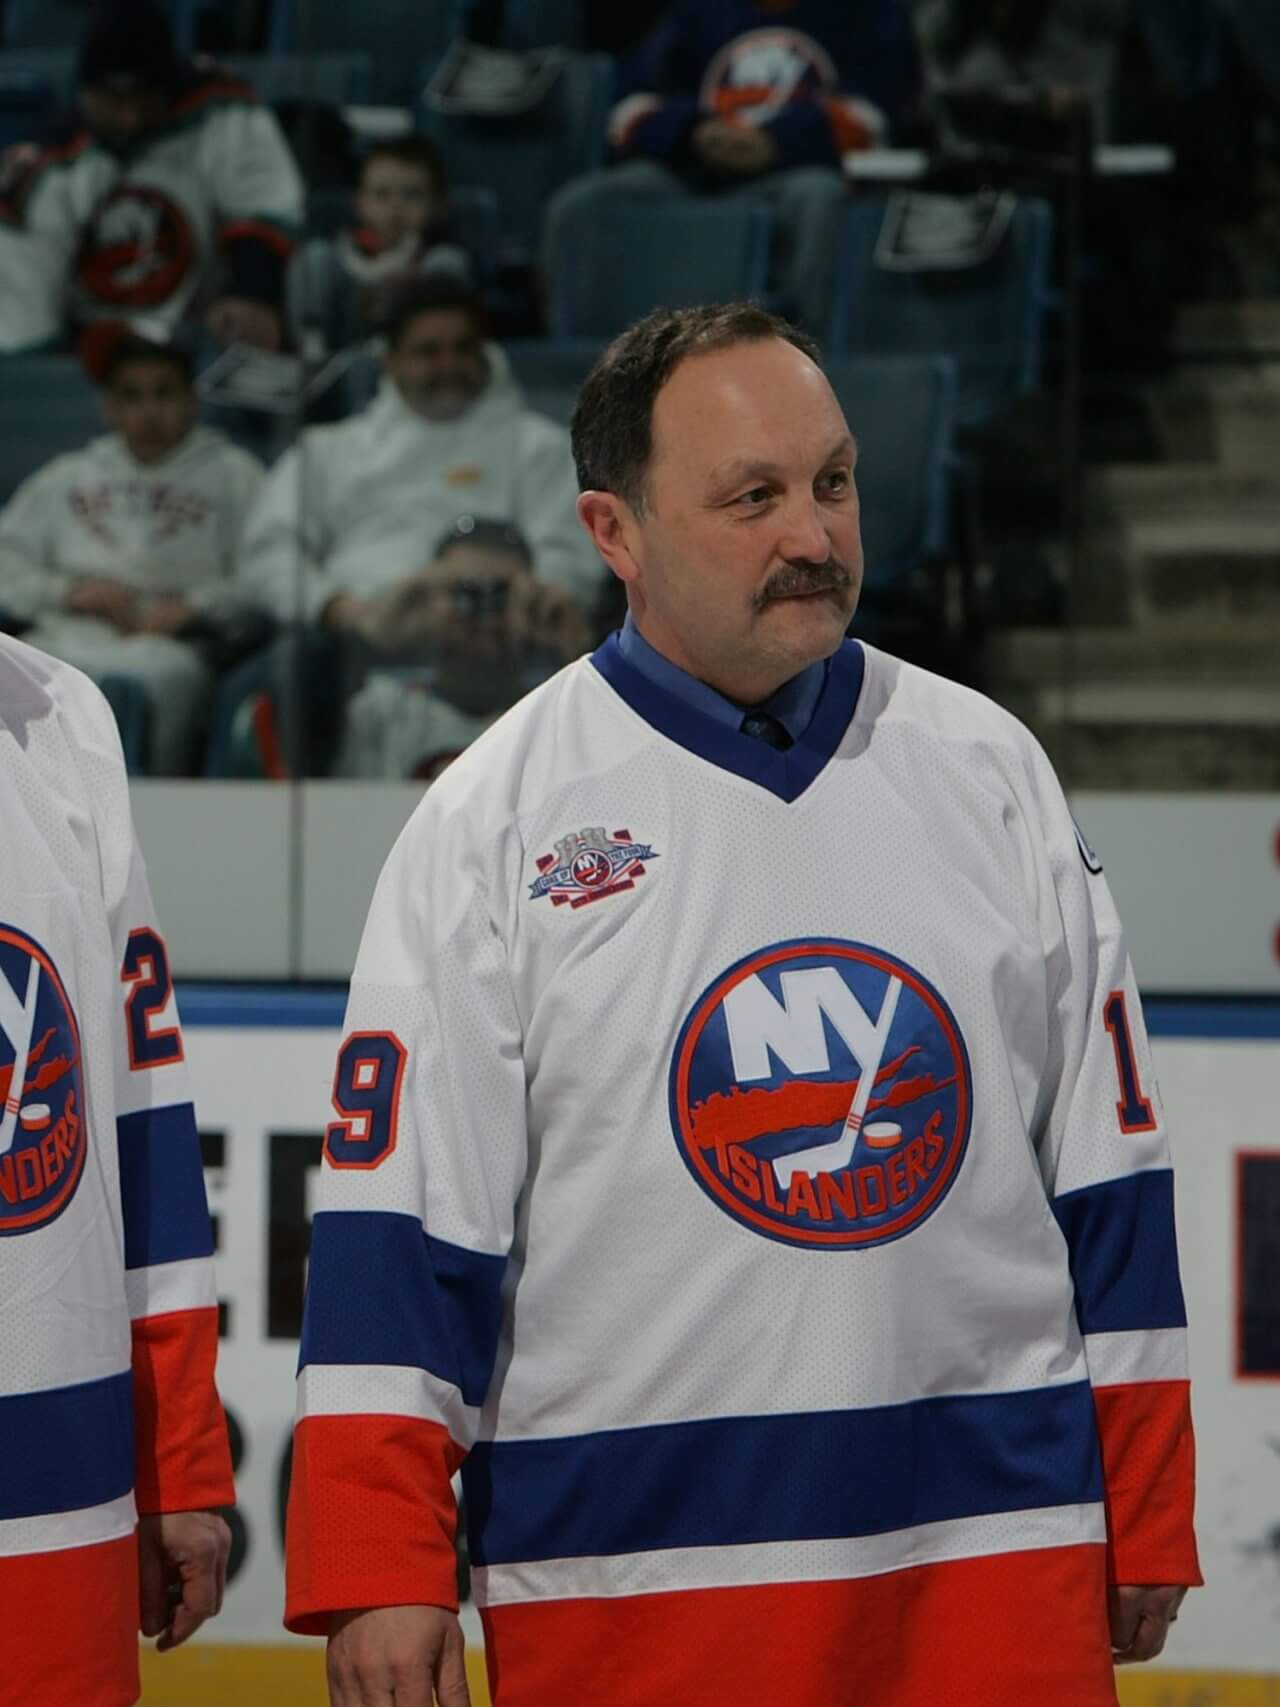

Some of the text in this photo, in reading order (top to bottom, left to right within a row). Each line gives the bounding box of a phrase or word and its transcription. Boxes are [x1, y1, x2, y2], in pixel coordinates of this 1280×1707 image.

[722, 966, 904, 1083] NY
[322, 1030, 408, 1170] 9
[715, 1109, 946, 1223] ISLANDERS
